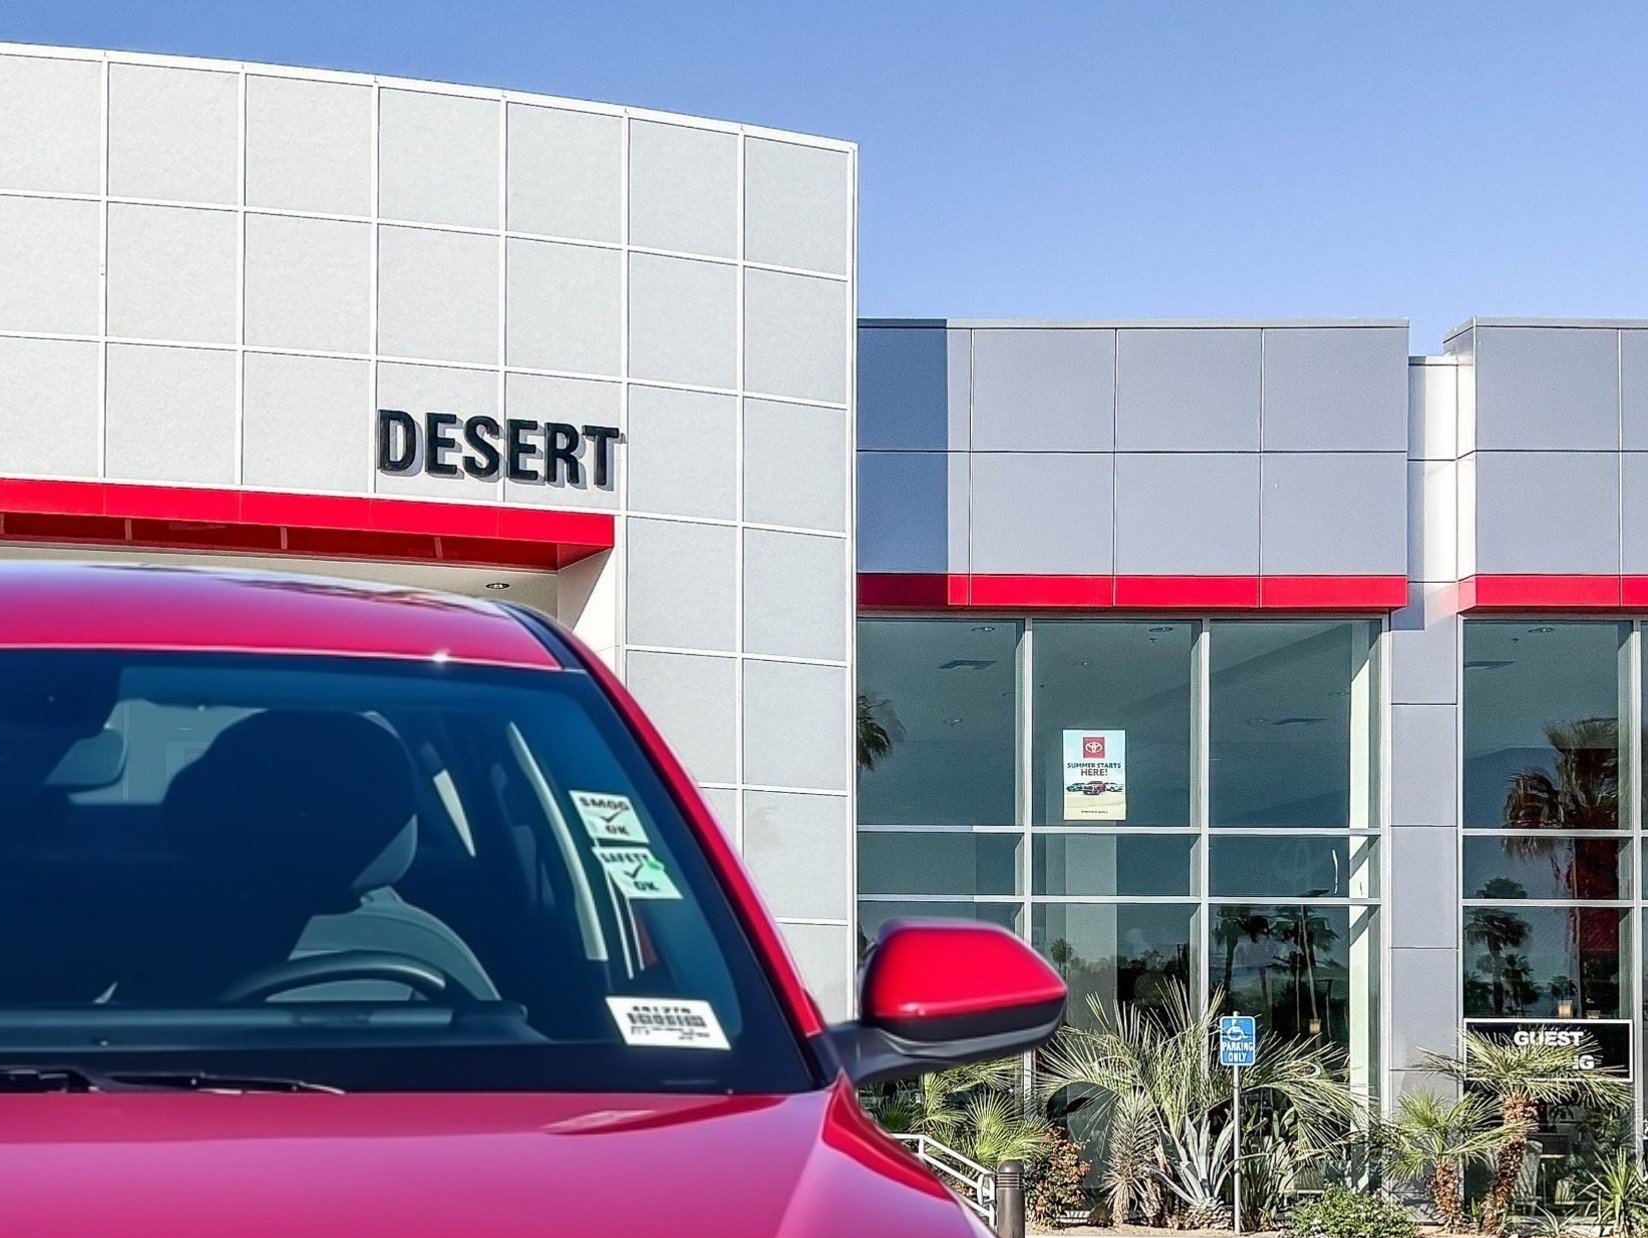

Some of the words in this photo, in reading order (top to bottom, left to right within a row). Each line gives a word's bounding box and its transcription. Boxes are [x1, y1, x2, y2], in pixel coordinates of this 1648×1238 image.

[377, 409, 620, 487] DESERT
[1080, 768, 1108, 776] HERE!
[579, 795, 630, 812] SMOG
[605, 824, 629, 836] OK
[633, 880, 660, 892] OK
[1513, 1031, 1584, 1047] GUEST
[1222, 1041, 1254, 1052] PARKING
[1228, 1052, 1248, 1062] ONLY
